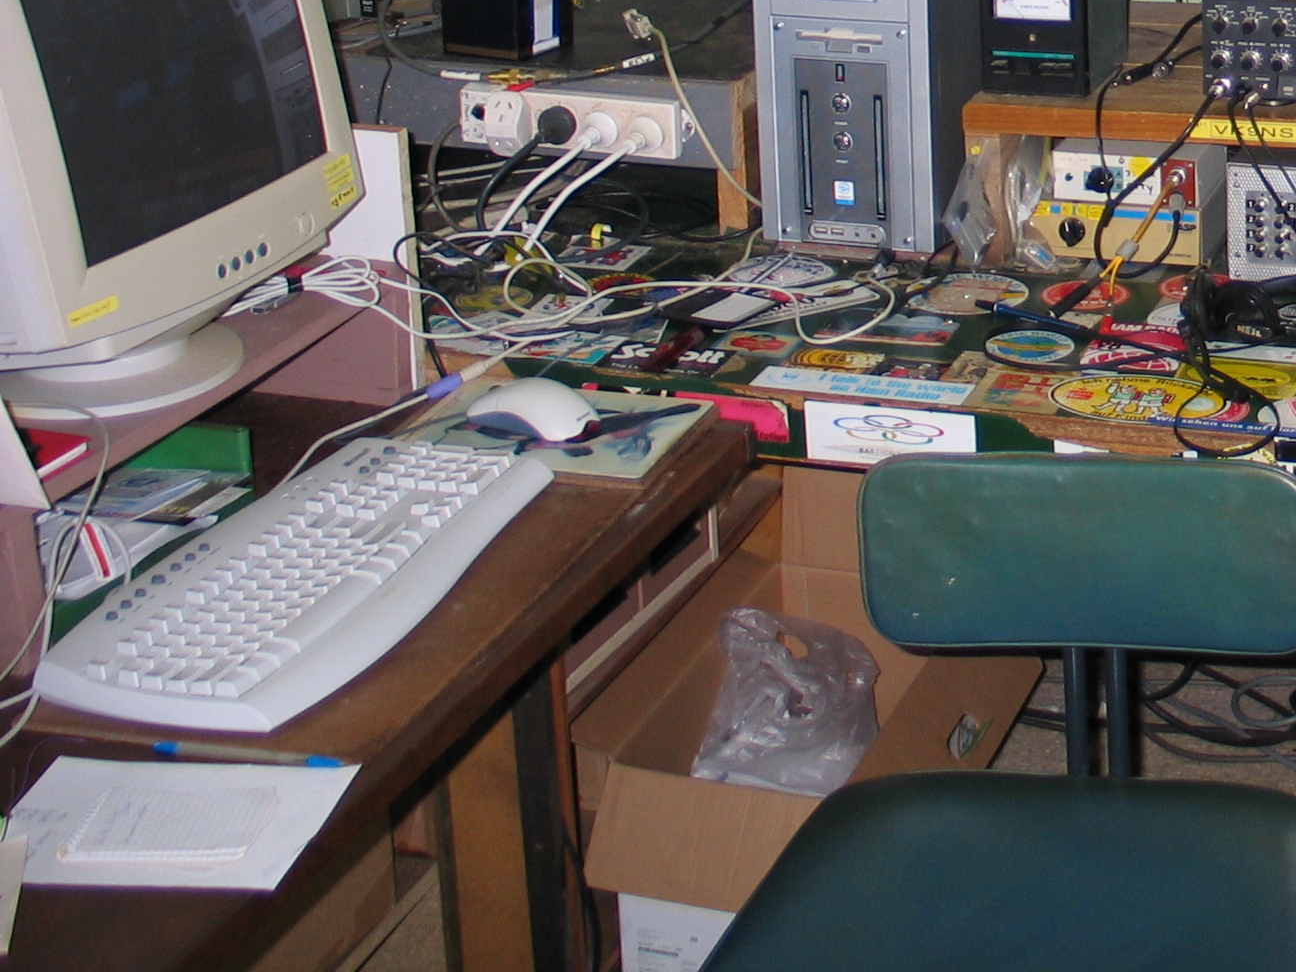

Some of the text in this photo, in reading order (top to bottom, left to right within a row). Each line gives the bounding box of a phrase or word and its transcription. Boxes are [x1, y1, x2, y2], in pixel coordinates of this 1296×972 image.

[1214, 124, 1294, 138] VK9NS
[1237, 326, 1262, 338] HEIL
[830, 374, 860, 384] talk
[864, 376, 880, 384] to
[886, 378, 912, 390] the
[916, 382, 966, 394] world
[854, 386, 890, 396] Ham
[894, 388, 942, 400] Radio
